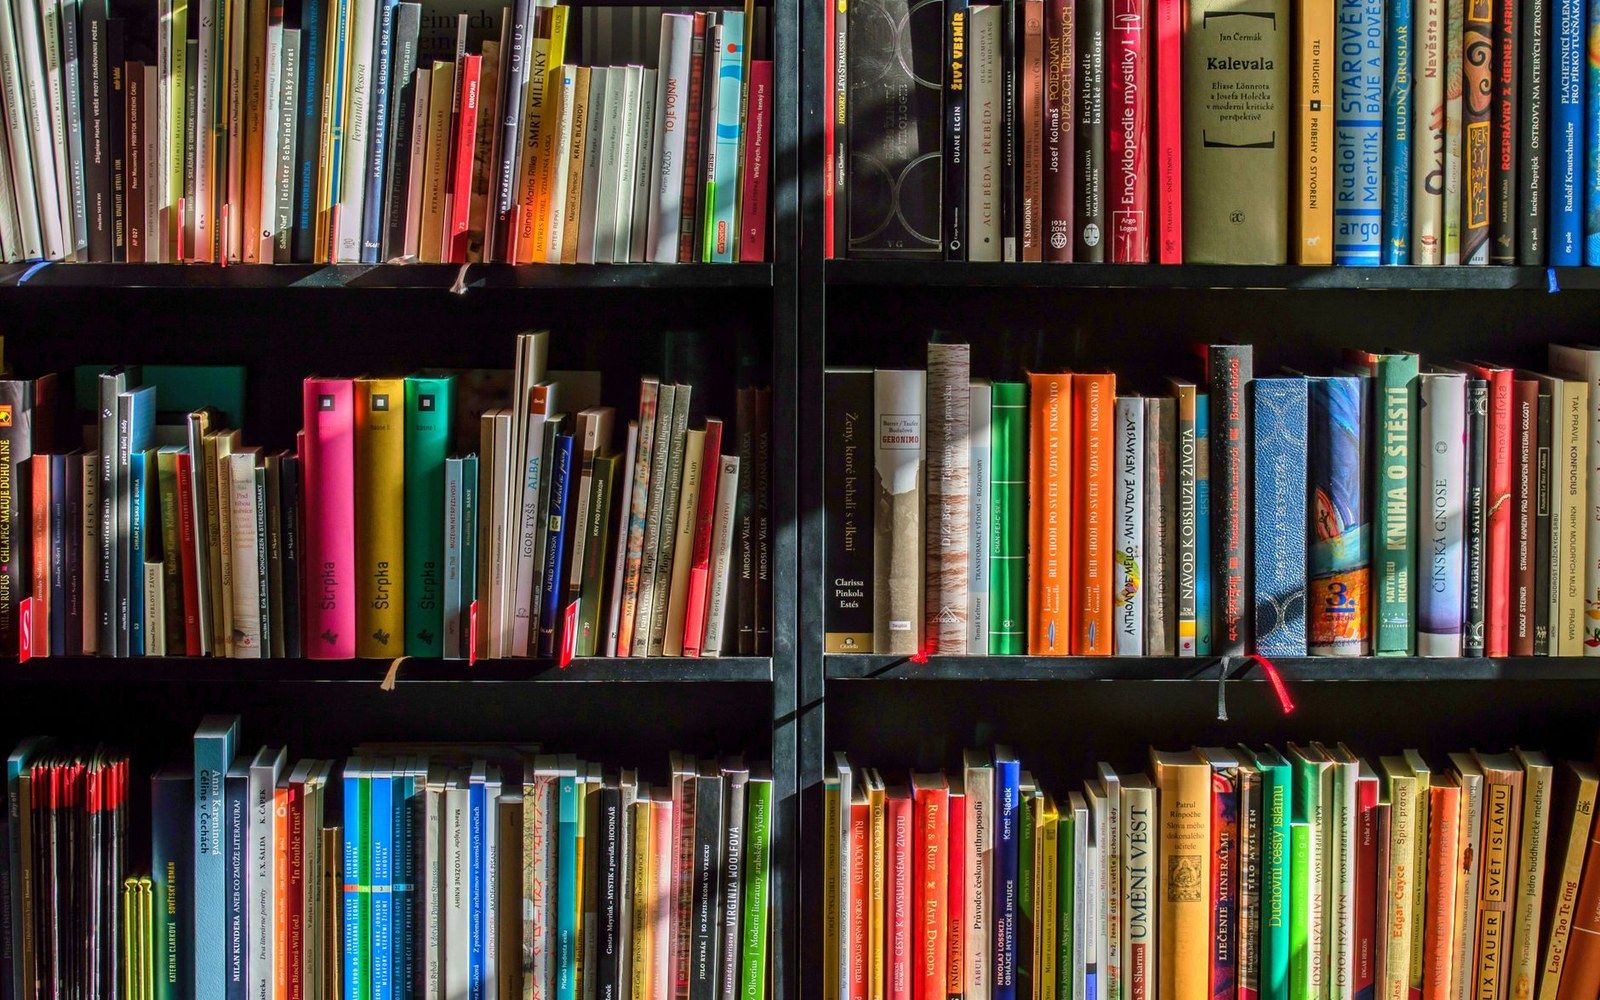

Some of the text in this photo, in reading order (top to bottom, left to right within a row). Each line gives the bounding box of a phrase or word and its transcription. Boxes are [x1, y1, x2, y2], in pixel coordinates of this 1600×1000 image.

[381, 5, 389, 25] teba
[380, 28, 388, 45] bez
[512, 24, 523, 72] KUBUS
[952, 12, 964, 59] VESMÍR
[1220, 32, 1262, 42] Jan Čermák
[286, 48, 294, 76] závrat
[378, 58, 387, 84] tebou
[951, 62, 963, 90] ŽIVÝ
[1093, 30, 1102, 124] baltské mytologie
[1122, 48, 1136, 104] mystiky
[1206, 57, 1274, 70] Kalevala
[468, 81, 476, 109] EUROPAIN
[667, 79, 677, 109] VOJNA!
[1082, 53, 1092, 124] Encyklopedie
[1396, 25, 1407, 140] BLUDNÝ BRUSLAŘ
[92, 98, 100, 116] VERŠE
[352, 64, 365, 142] Fernando Pessoa
[667, 111, 676, 120] JE
[283, 114, 291, 160] Schwindel
[375, 103, 384, 143] PETERAJ
[666, 121, 674, 133] TO
[374, 148, 382, 177] KAMIL
[522, 51, 546, 238] Rainer Maria Rilke SMRŤ MILENKY
[1122, 109, 1136, 204] Encyklopedie
[1338, 132, 1355, 202] Rudolf
[1363, 132, 1378, 202] Mertlík
[1531, 156, 1540, 189] Deprijck
[1565, 122, 1574, 212] Rudolf Krautschneider
[1339, 222, 1379, 242] argo
[882, 436, 919, 444] GERONIMO
[528, 457, 539, 490] ALBA
[689, 460, 697, 486] BALADY
[1383, 386, 1408, 550] KNIHA O ŠTĚSTÍ
[1179, 428, 1194, 599] NÁVOD K OBSLUZE ŽIVOTA
[523, 532, 534, 558] IGOR
[742, 516, 751, 579] MIROSLAV VÁLEK
[1431, 478, 1447, 592] ČÍNSKÁ GNOSE
[1471, 487, 1481, 610] FRATERNITAS SATURNI
[835, 578, 864, 587] Clarissa
[835, 589, 864, 599] Pinkola
[1386, 562, 1396, 603] MATTHIEU
[1399, 571, 1407, 602] RICARD
[840, 599, 859, 608] Estés
[973, 622, 982, 640] Tomáš
[200, 770, 209, 801] Céline
[212, 770, 221, 855] Anna Kareninová
[895, 815, 906, 847] ŽIVOTU
[1003, 788, 1012, 840] Karel Sládek
[200, 812, 209, 854] Čechách
[292, 837, 300, 867] double
[1485, 790, 1506, 896] SVĚT ISLÁMU
[1526, 780, 1544, 896] Jádro buddhistické meditace
[232, 851, 240, 878] ZMŮŽE
[608, 842, 616, 867] povídka
[974, 859, 982, 888] českou
[1124, 805, 1148, 940] UMĚNÍ VÉST
[1268, 785, 1284, 927] Duchovní cesty islámu
[234, 879, 240, 890] CO
[727, 827, 739, 926] VIRGINIA WOOLFOVÁ
[748, 799, 764, 995] Oliverius Moderní literatury arabského Východu
[974, 891, 982, 930] Průvodce
[1216, 832, 1229, 960] LIEČENIE MINERÁLMI
[1393, 865, 1405, 938] Edgar Cayce
[473, 909, 481, 946] problematiky
[895, 930, 904, 956] CESTA
[1484, 917, 1497, 971] TAUER
